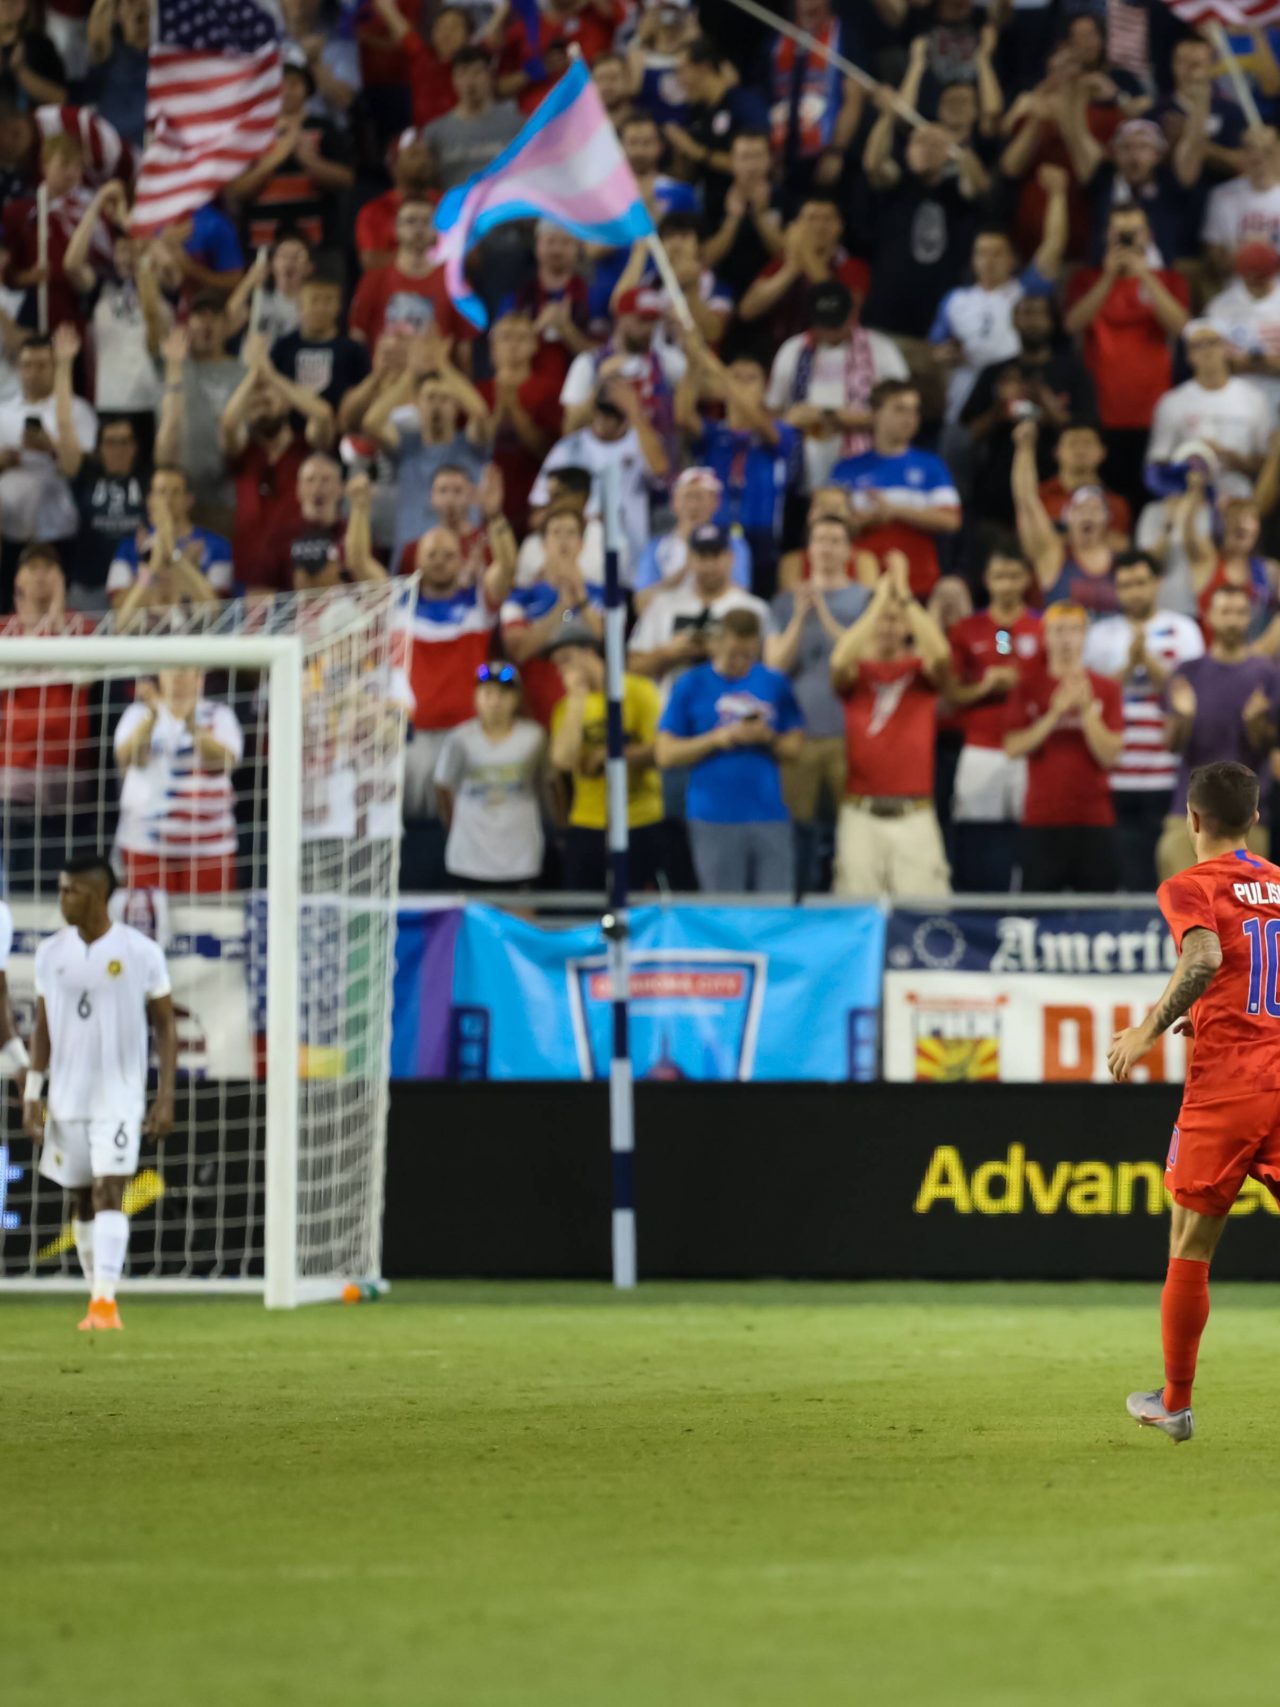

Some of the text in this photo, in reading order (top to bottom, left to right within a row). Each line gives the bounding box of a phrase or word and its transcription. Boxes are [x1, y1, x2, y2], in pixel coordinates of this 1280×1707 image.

[989, 915, 1179, 973] Ameri
[76, 991, 92, 1019] 6
[113, 1121, 129, 1148] 6
